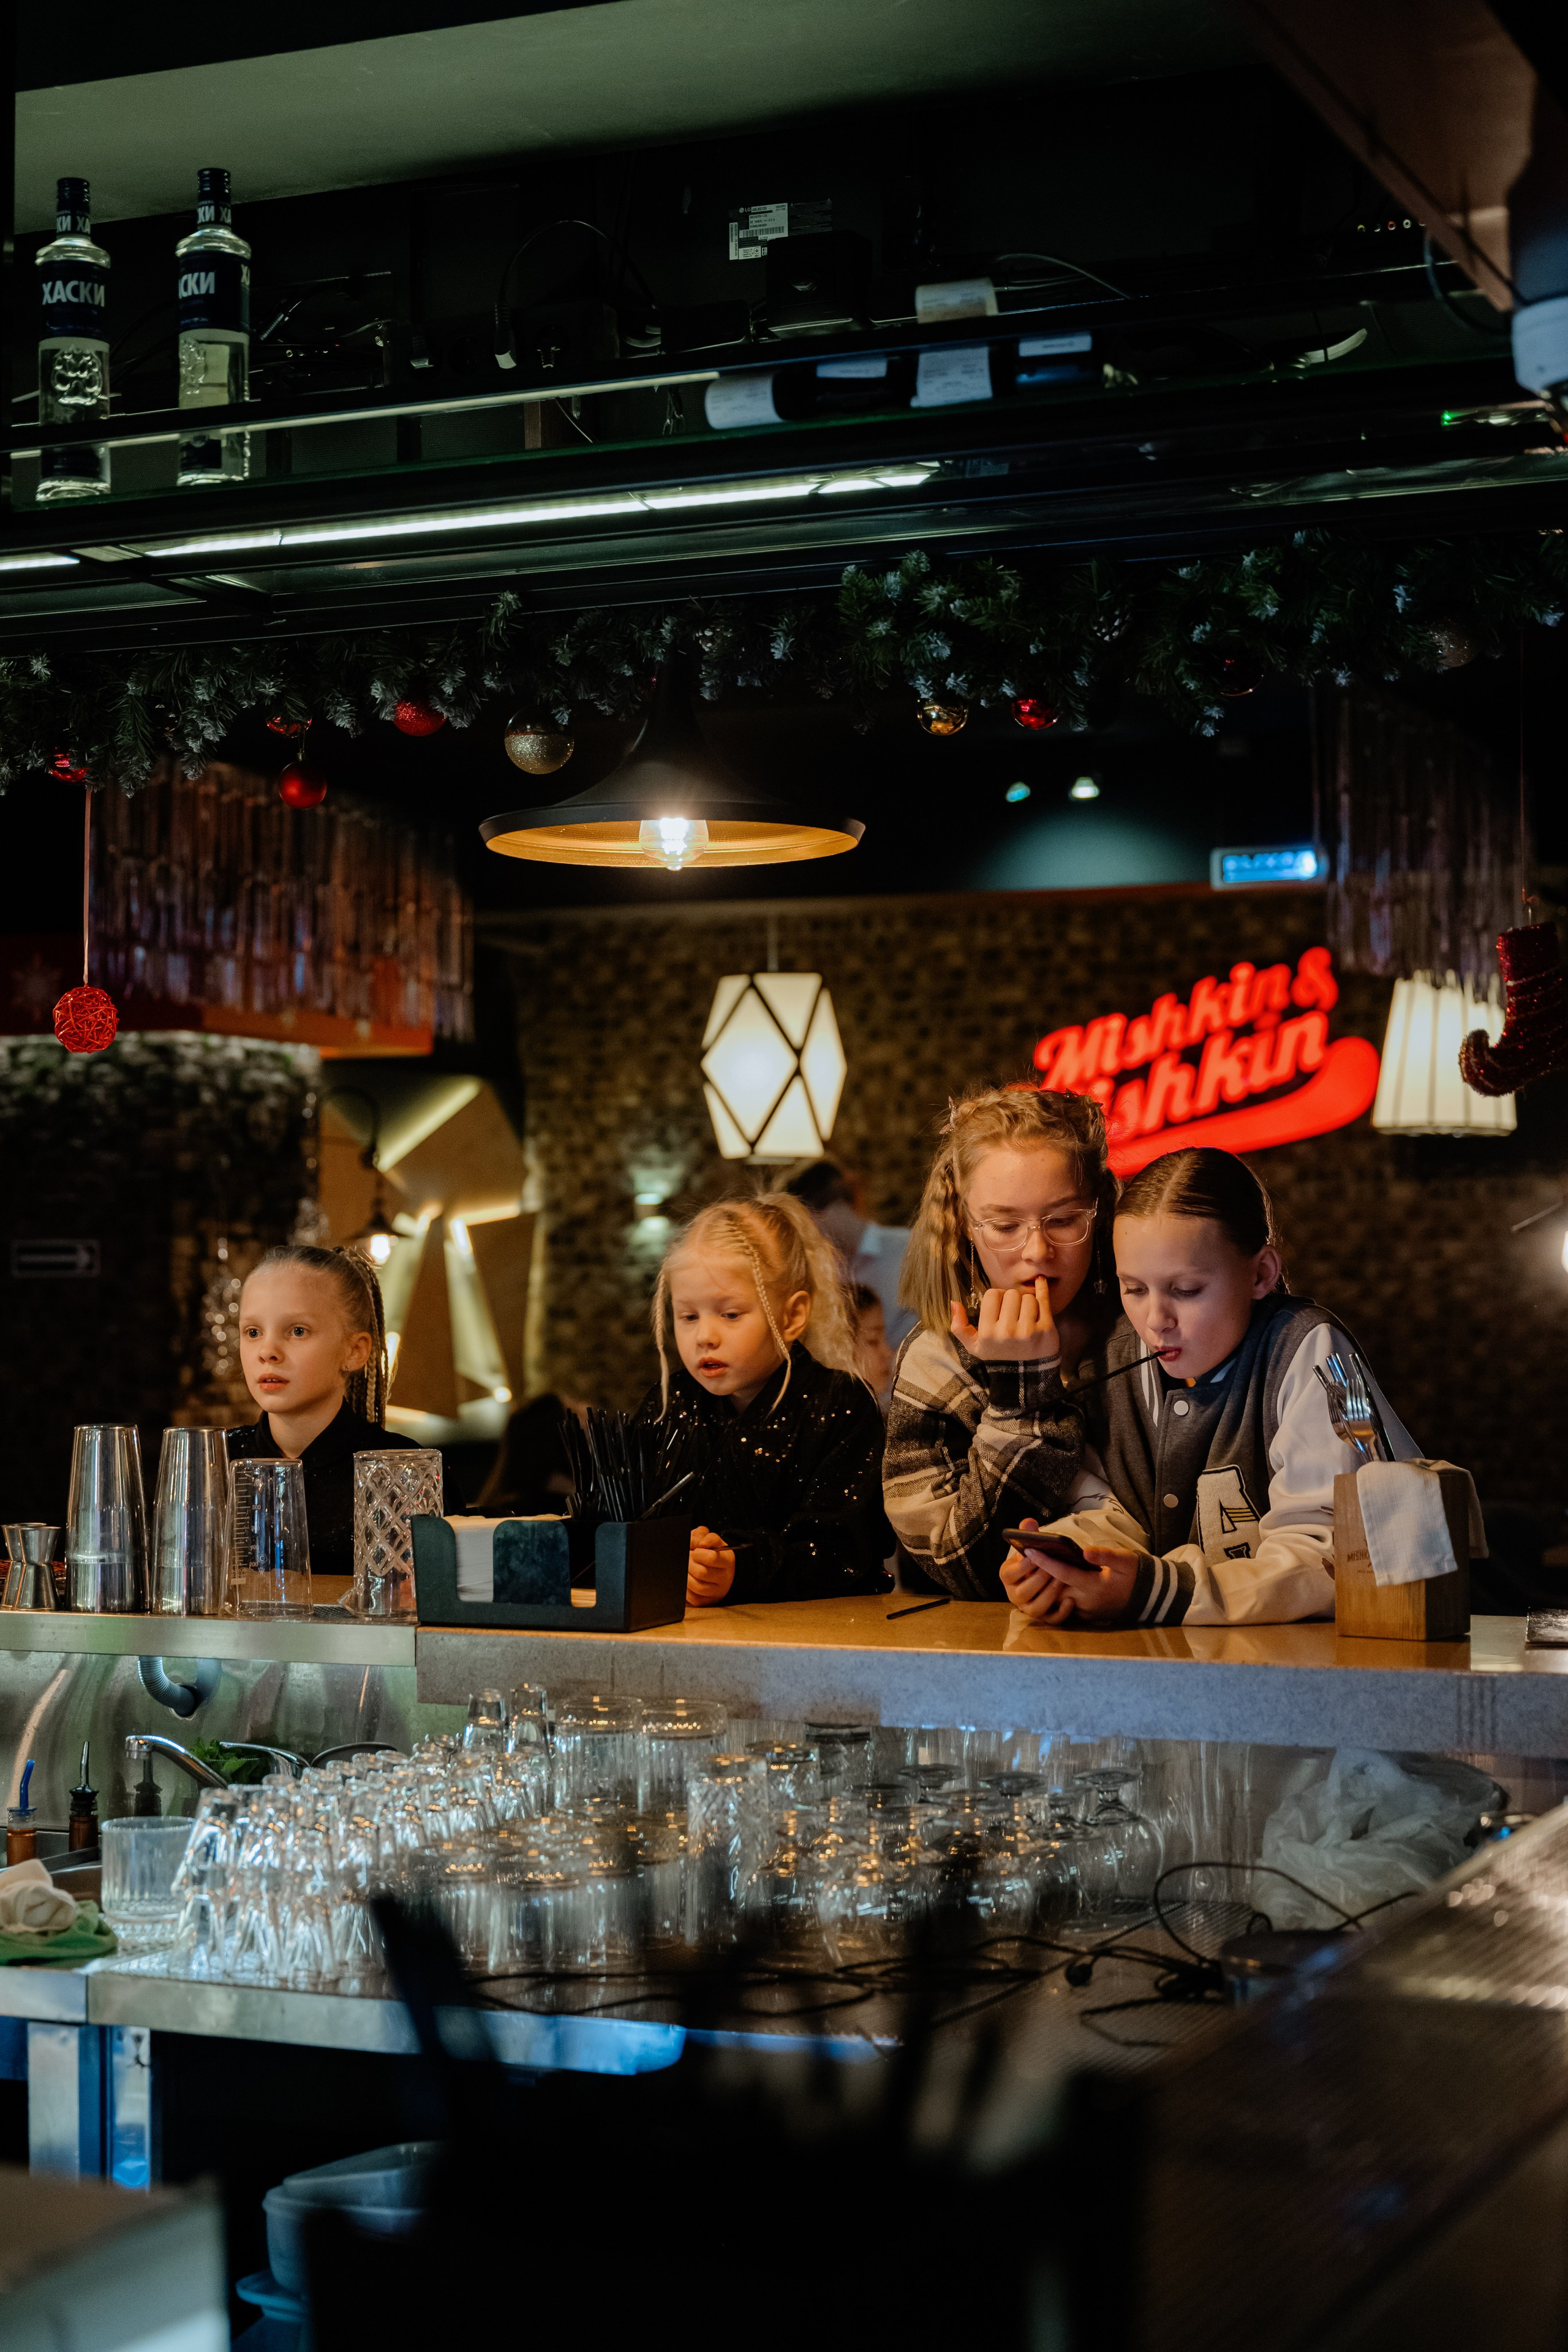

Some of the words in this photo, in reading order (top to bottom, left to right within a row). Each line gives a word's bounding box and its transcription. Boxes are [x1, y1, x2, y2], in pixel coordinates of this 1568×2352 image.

[42, 280, 105, 307] ХАСКИ
[1033, 946, 1339, 1088] Mishkins
[1085, 1009, 1330, 1140] ishkin
